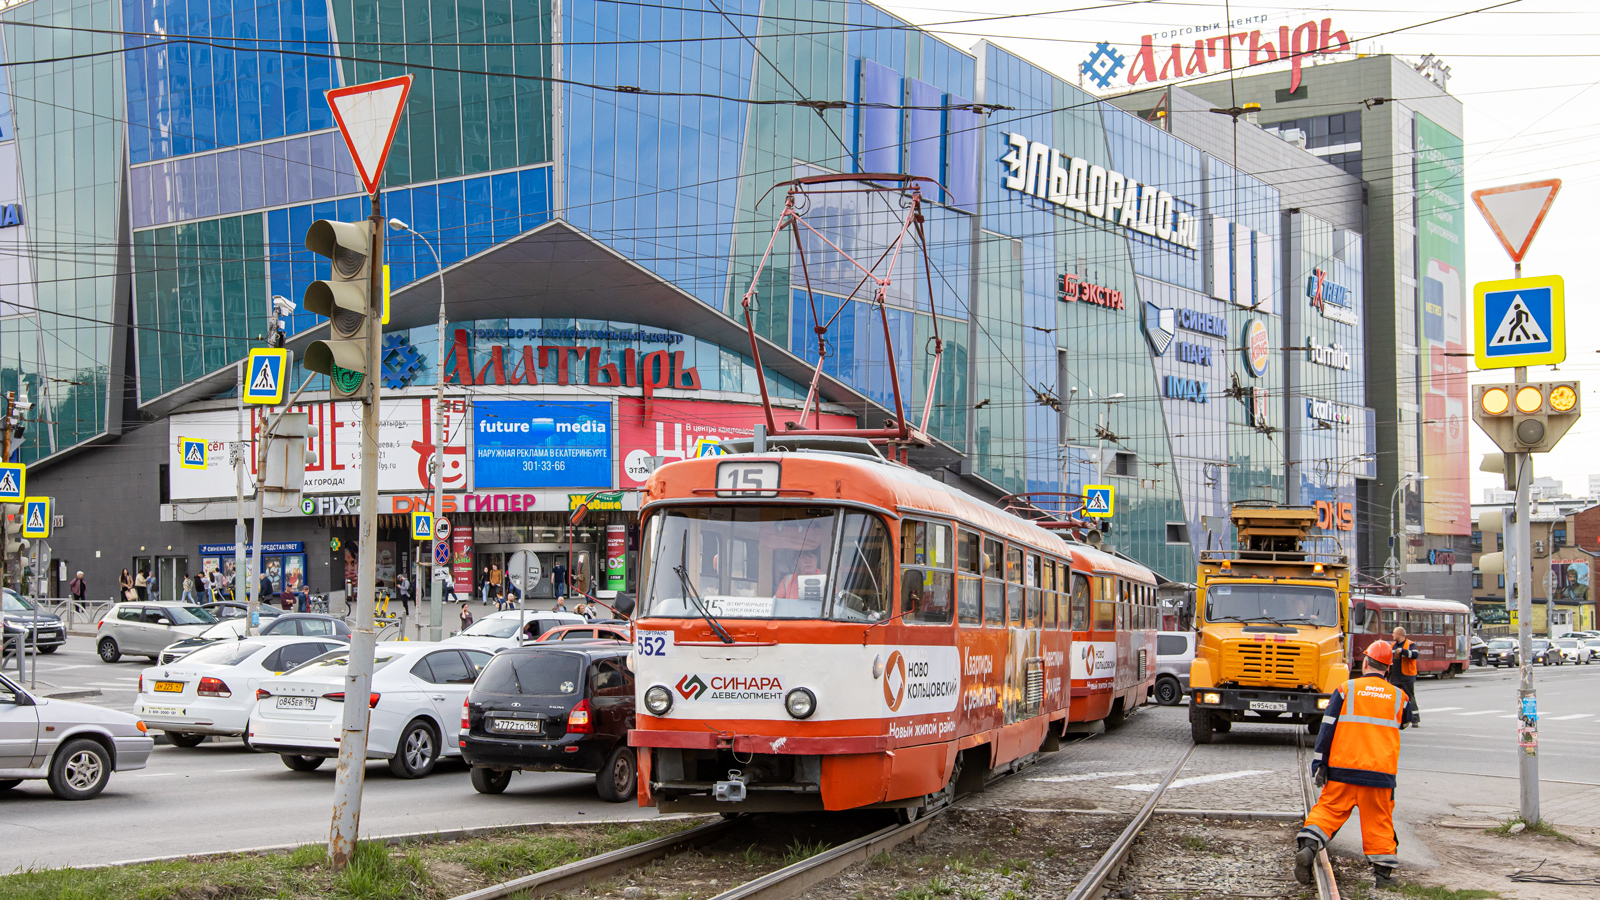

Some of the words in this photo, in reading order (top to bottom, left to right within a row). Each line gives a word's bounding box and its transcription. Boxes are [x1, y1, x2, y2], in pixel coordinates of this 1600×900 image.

[1127, 18, 1350, 94] Алатырь
[1080, 281, 1125, 310] ЭКСТРА
[1426, 302, 1442, 316] METRO
[1181, 308, 1229, 338] СИНЕМА
[1182, 342, 1213, 366] ПАРК
[443, 328, 702, 427] Алатырь
[1167, 374, 1210, 404] IMAX
[480, 420, 530, 433] future
[556, 420, 606, 433] media
[693, 425, 716, 434] центре
[478, 449, 516, 458] НАРУЖНАЯ
[516, 449, 549, 458] РЕКЛАМА
[550, 449, 554, 458] В
[555, 448, 607, 458] ЕКАТЕРИНБУРГЕ
[522, 461, 565, 471] 301-33-66
[314, 478, 345, 486] ГОРОДА!
[727, 469, 763, 496] 15
[318, 497, 349, 515] FIX
[392, 495, 458, 513] DNS
[464, 494, 536, 512] ГИПЕР
[1315, 500, 1353, 530] DNS
[638, 636, 665, 656] 552
[908, 662, 929, 678] НОВО
[964, 646, 993, 683] Квартиры
[710, 677, 782, 690] СИНАРА
[908, 678, 957, 699] КОЛЬЦОВСКИЙ
[1357, 691, 1393, 699] ГОРТРАНС
[889, 720, 913, 739] Новый
[915, 718, 937, 736] жилой
[939, 717, 956, 736] район
